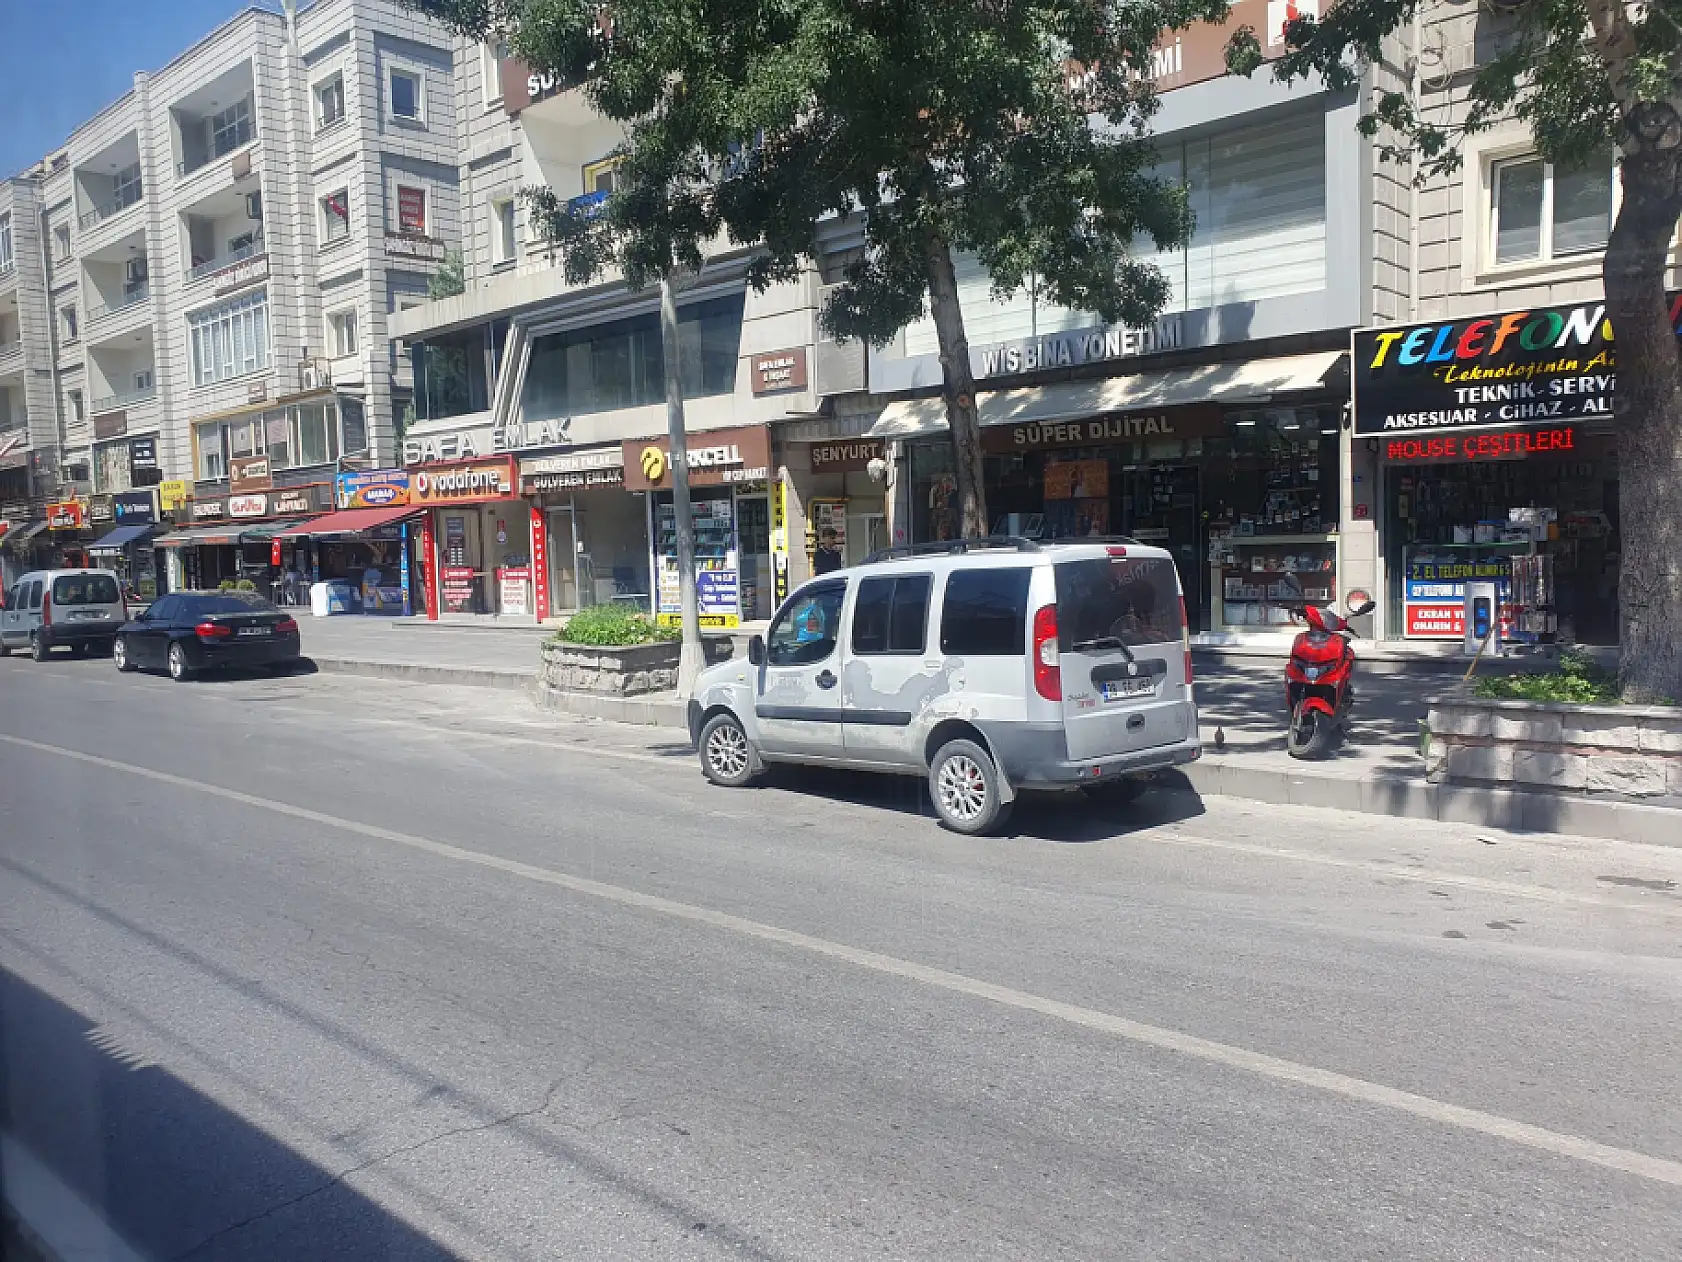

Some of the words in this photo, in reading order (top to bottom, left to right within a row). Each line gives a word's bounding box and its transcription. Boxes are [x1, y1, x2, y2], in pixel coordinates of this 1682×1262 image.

[1013, 421, 1083, 444] SÜPER
[1088, 415, 1175, 438] DİJİTAL
[1384, 408, 1477, 429] AKSESUAR
[493, 418, 572, 450] EMLAK
[664, 445, 744, 470] TKCELL
[1387, 436, 1457, 459] MOUSE
[431, 467, 499, 491] vodafone
